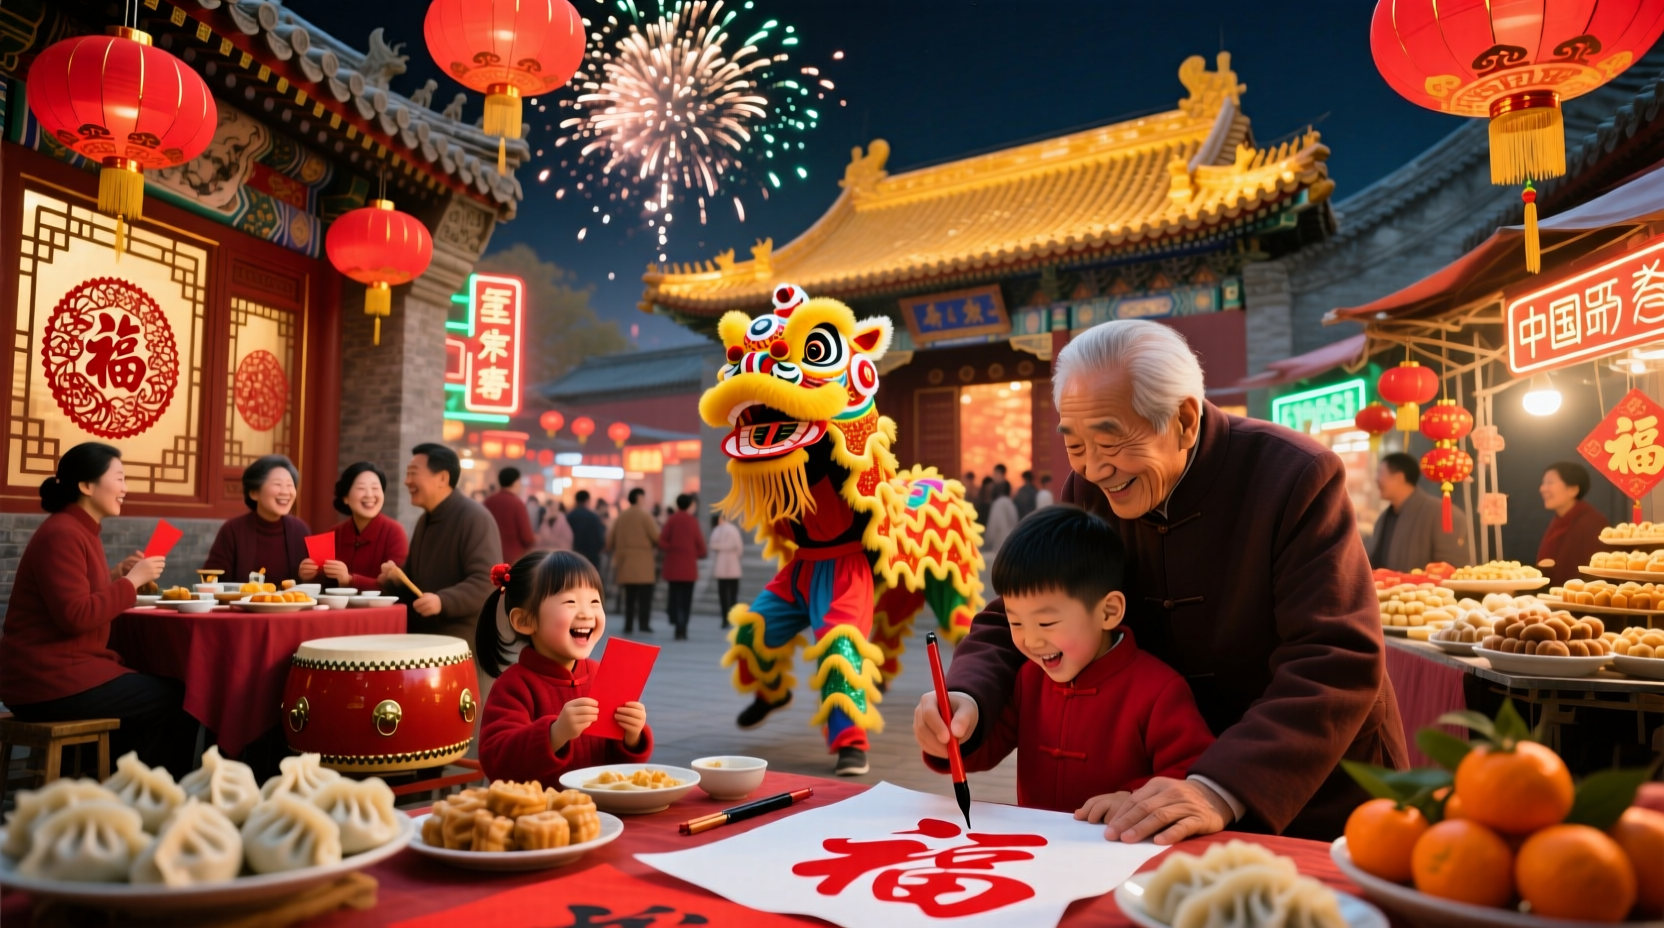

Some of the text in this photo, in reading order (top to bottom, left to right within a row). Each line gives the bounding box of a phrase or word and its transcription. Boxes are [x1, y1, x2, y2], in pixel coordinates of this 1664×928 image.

[86, 313, 146, 393] 福
[1604, 415, 1664, 475] 福
[791, 818, 1048, 918] 福
